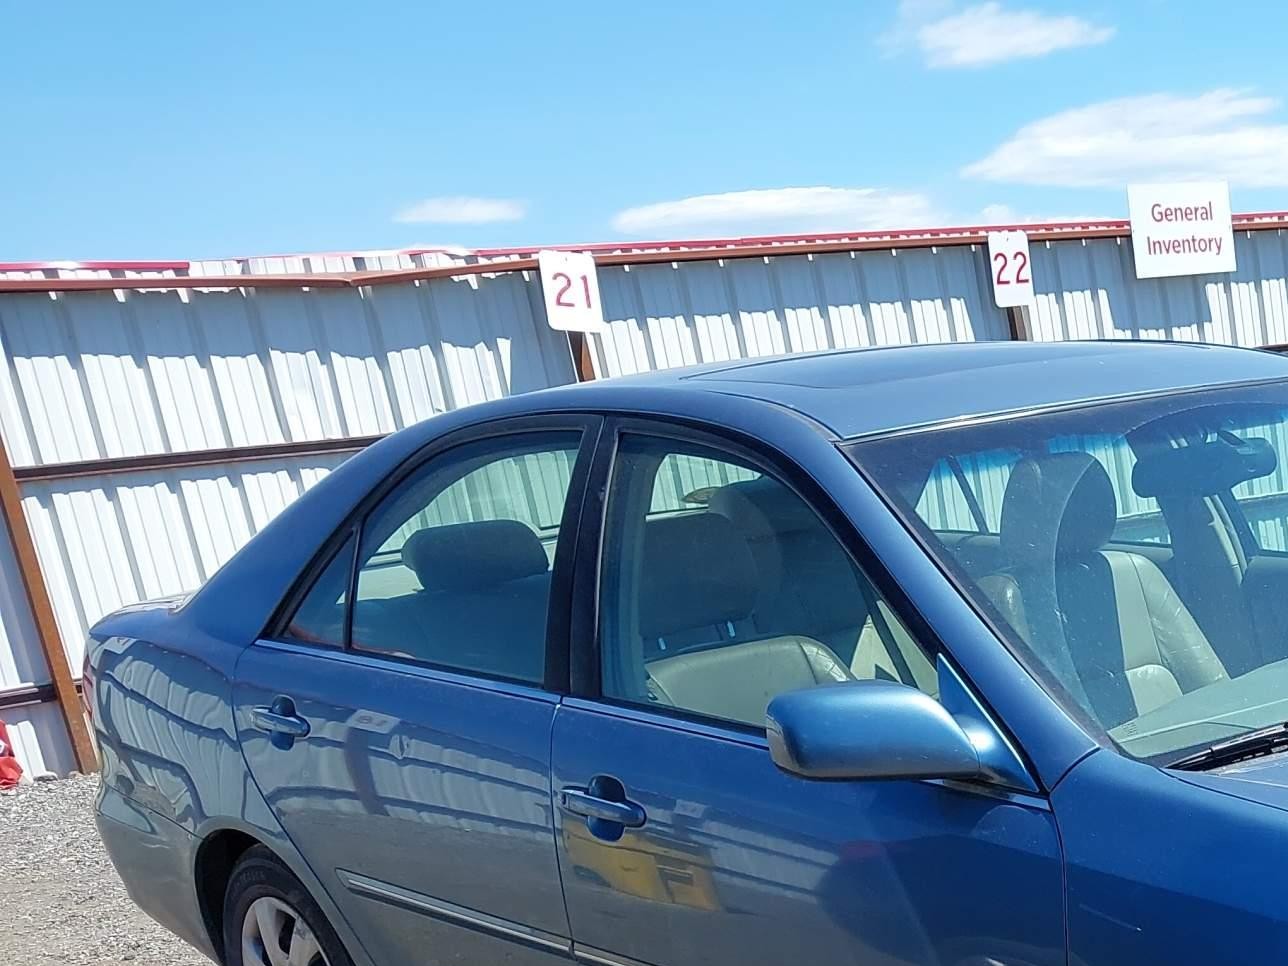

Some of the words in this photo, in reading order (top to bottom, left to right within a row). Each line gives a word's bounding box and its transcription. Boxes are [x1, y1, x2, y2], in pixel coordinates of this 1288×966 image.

[1151, 201, 1213, 223] General
[1146, 235, 1223, 256] Inventory
[994, 251, 1030, 285] 22
[552, 272, 592, 309] 21
